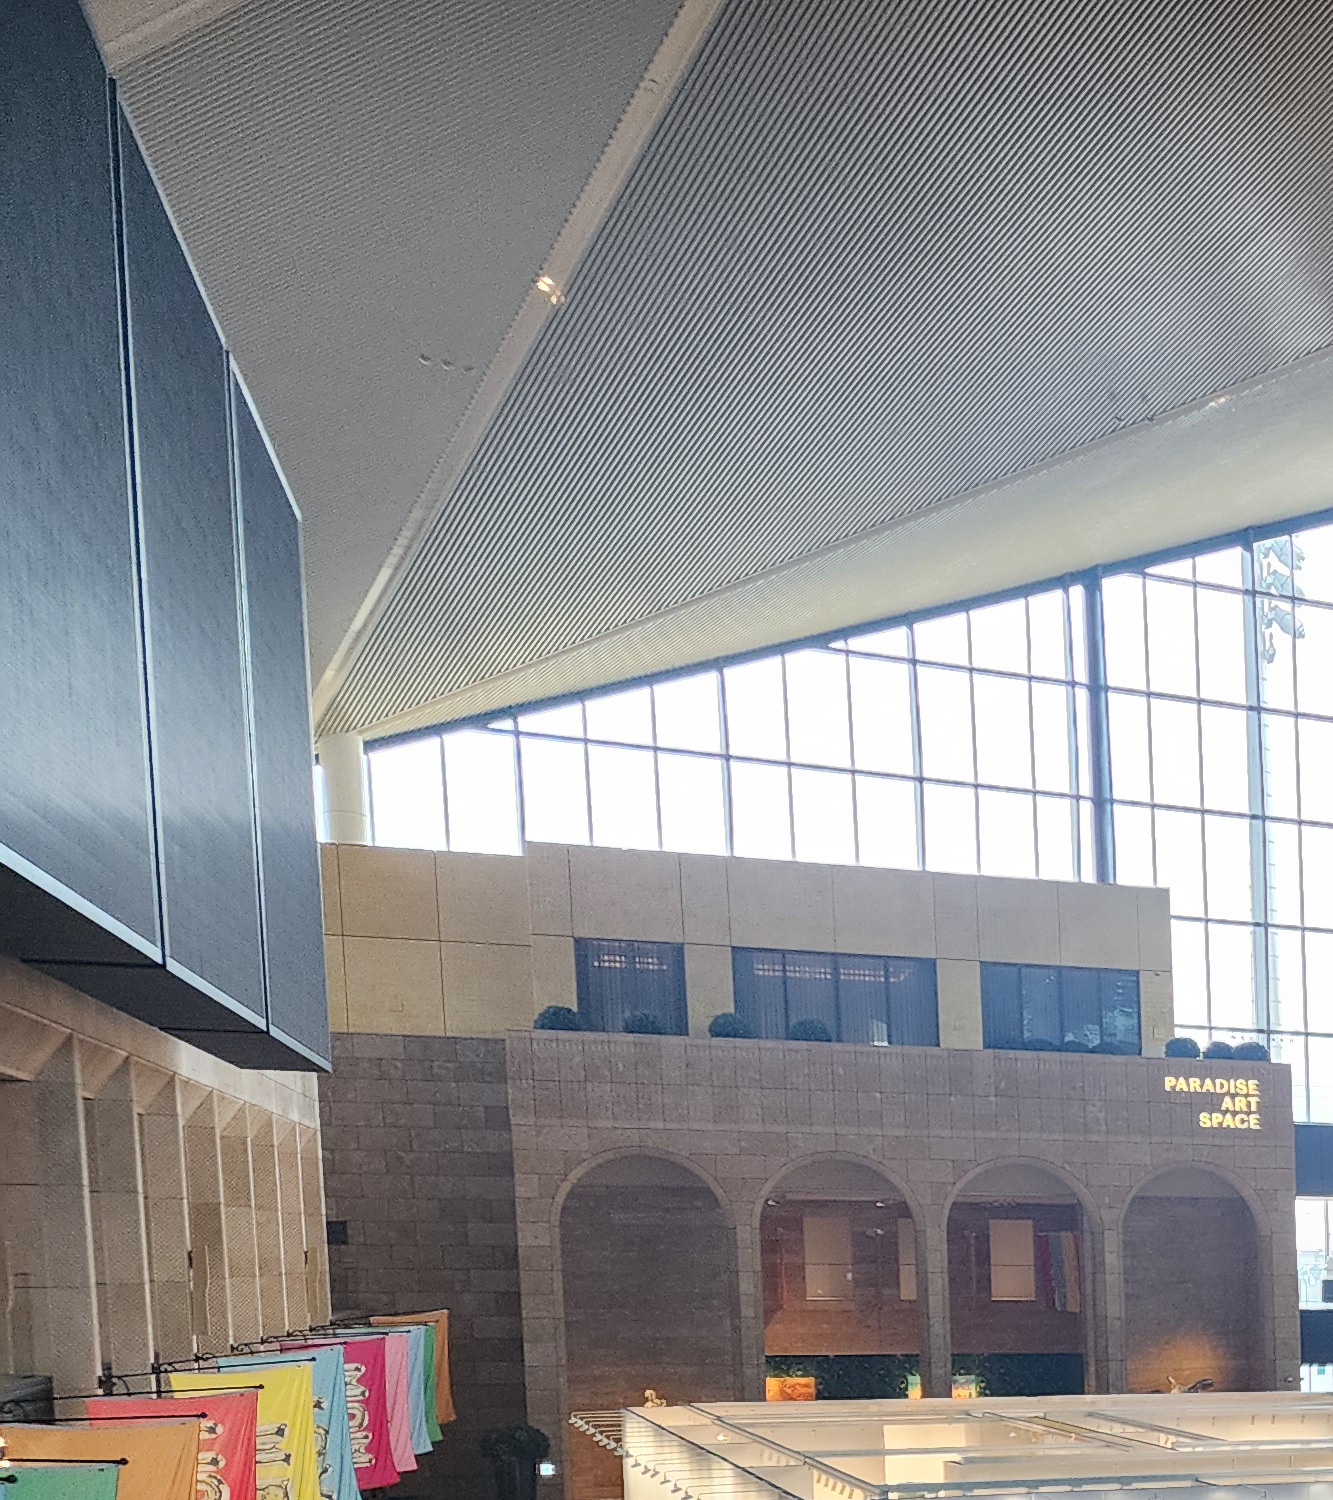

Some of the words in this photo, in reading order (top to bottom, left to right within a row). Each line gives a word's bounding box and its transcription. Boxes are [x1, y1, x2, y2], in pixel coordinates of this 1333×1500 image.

[1164, 1076, 1260, 1095] PARADISE
[1221, 1095, 1261, 1111] ART
[1199, 1112, 1261, 1130] SPACE
